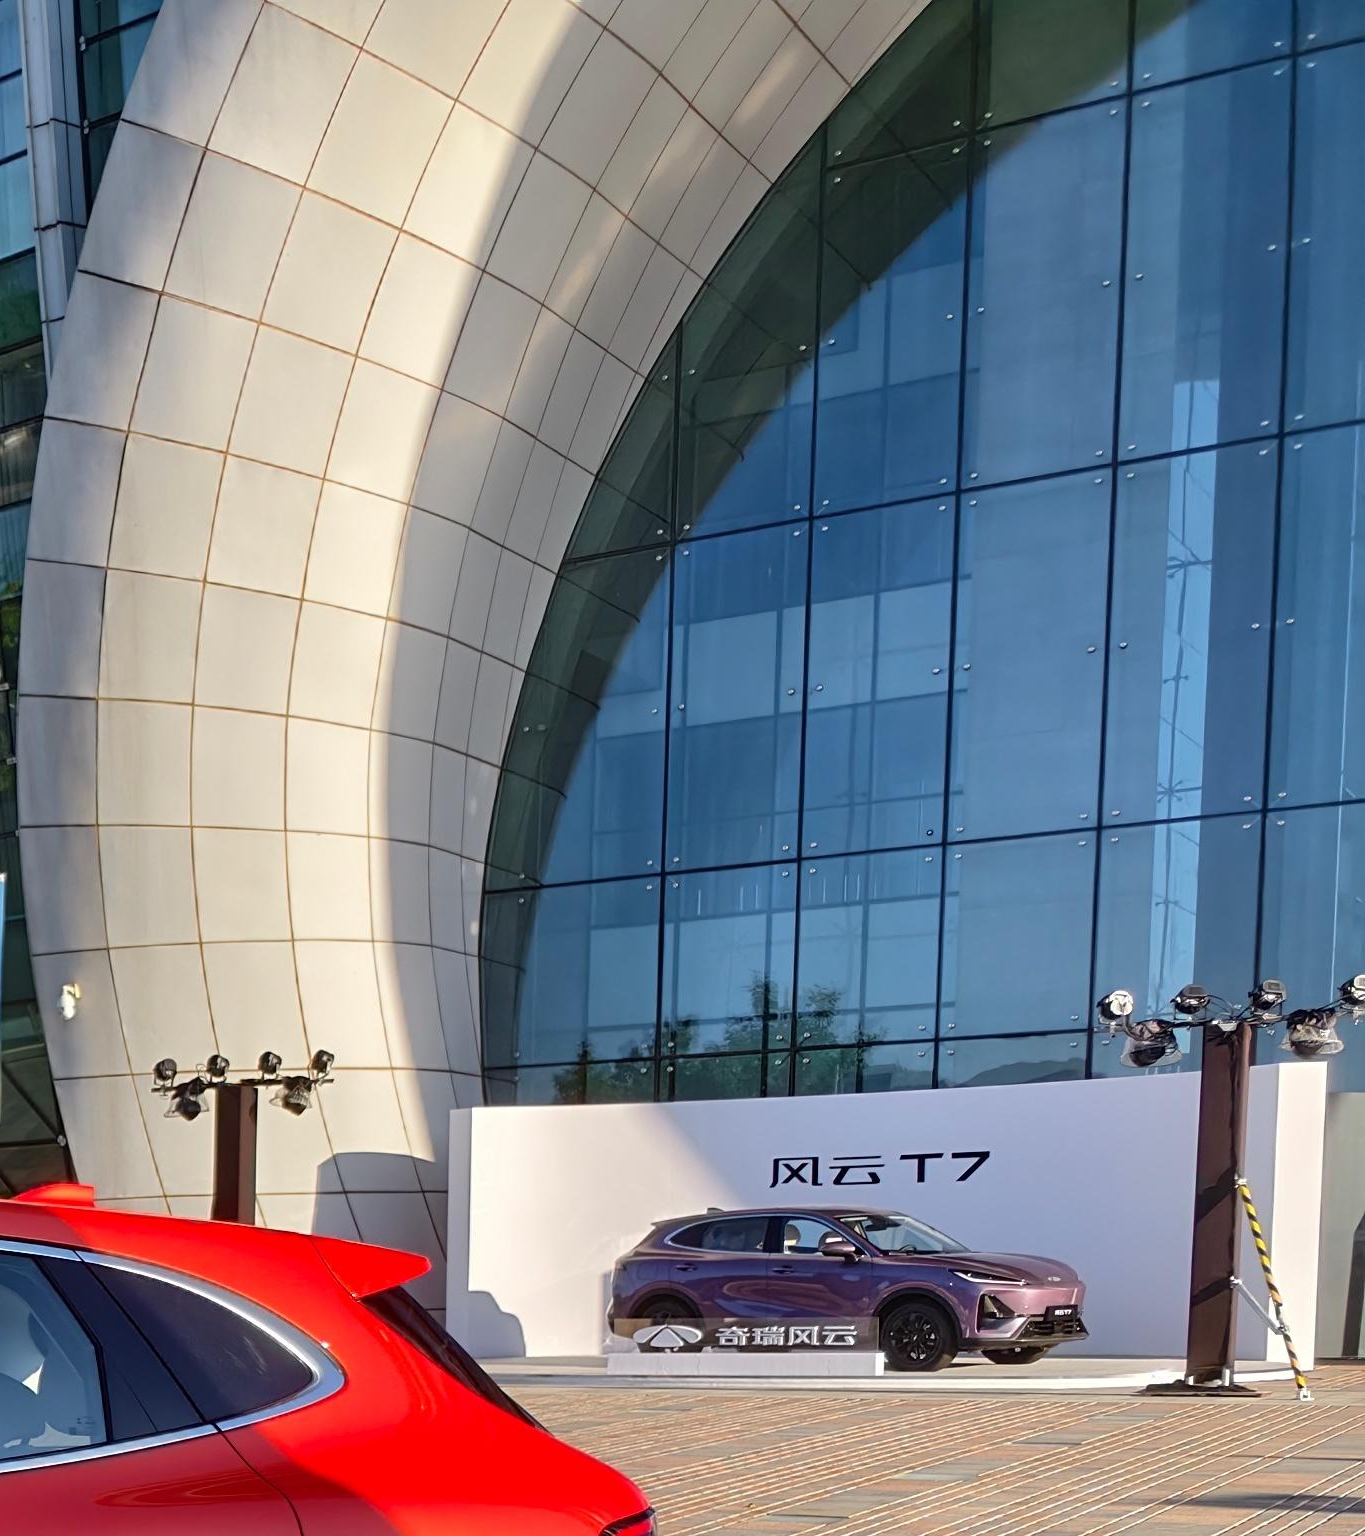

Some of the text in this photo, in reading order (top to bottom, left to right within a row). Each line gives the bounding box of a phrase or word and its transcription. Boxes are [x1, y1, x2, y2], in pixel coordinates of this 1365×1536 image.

[769, 1150, 991, 1189] 风云 T7
[715, 1325, 858, 1346] 奇瑞风云
